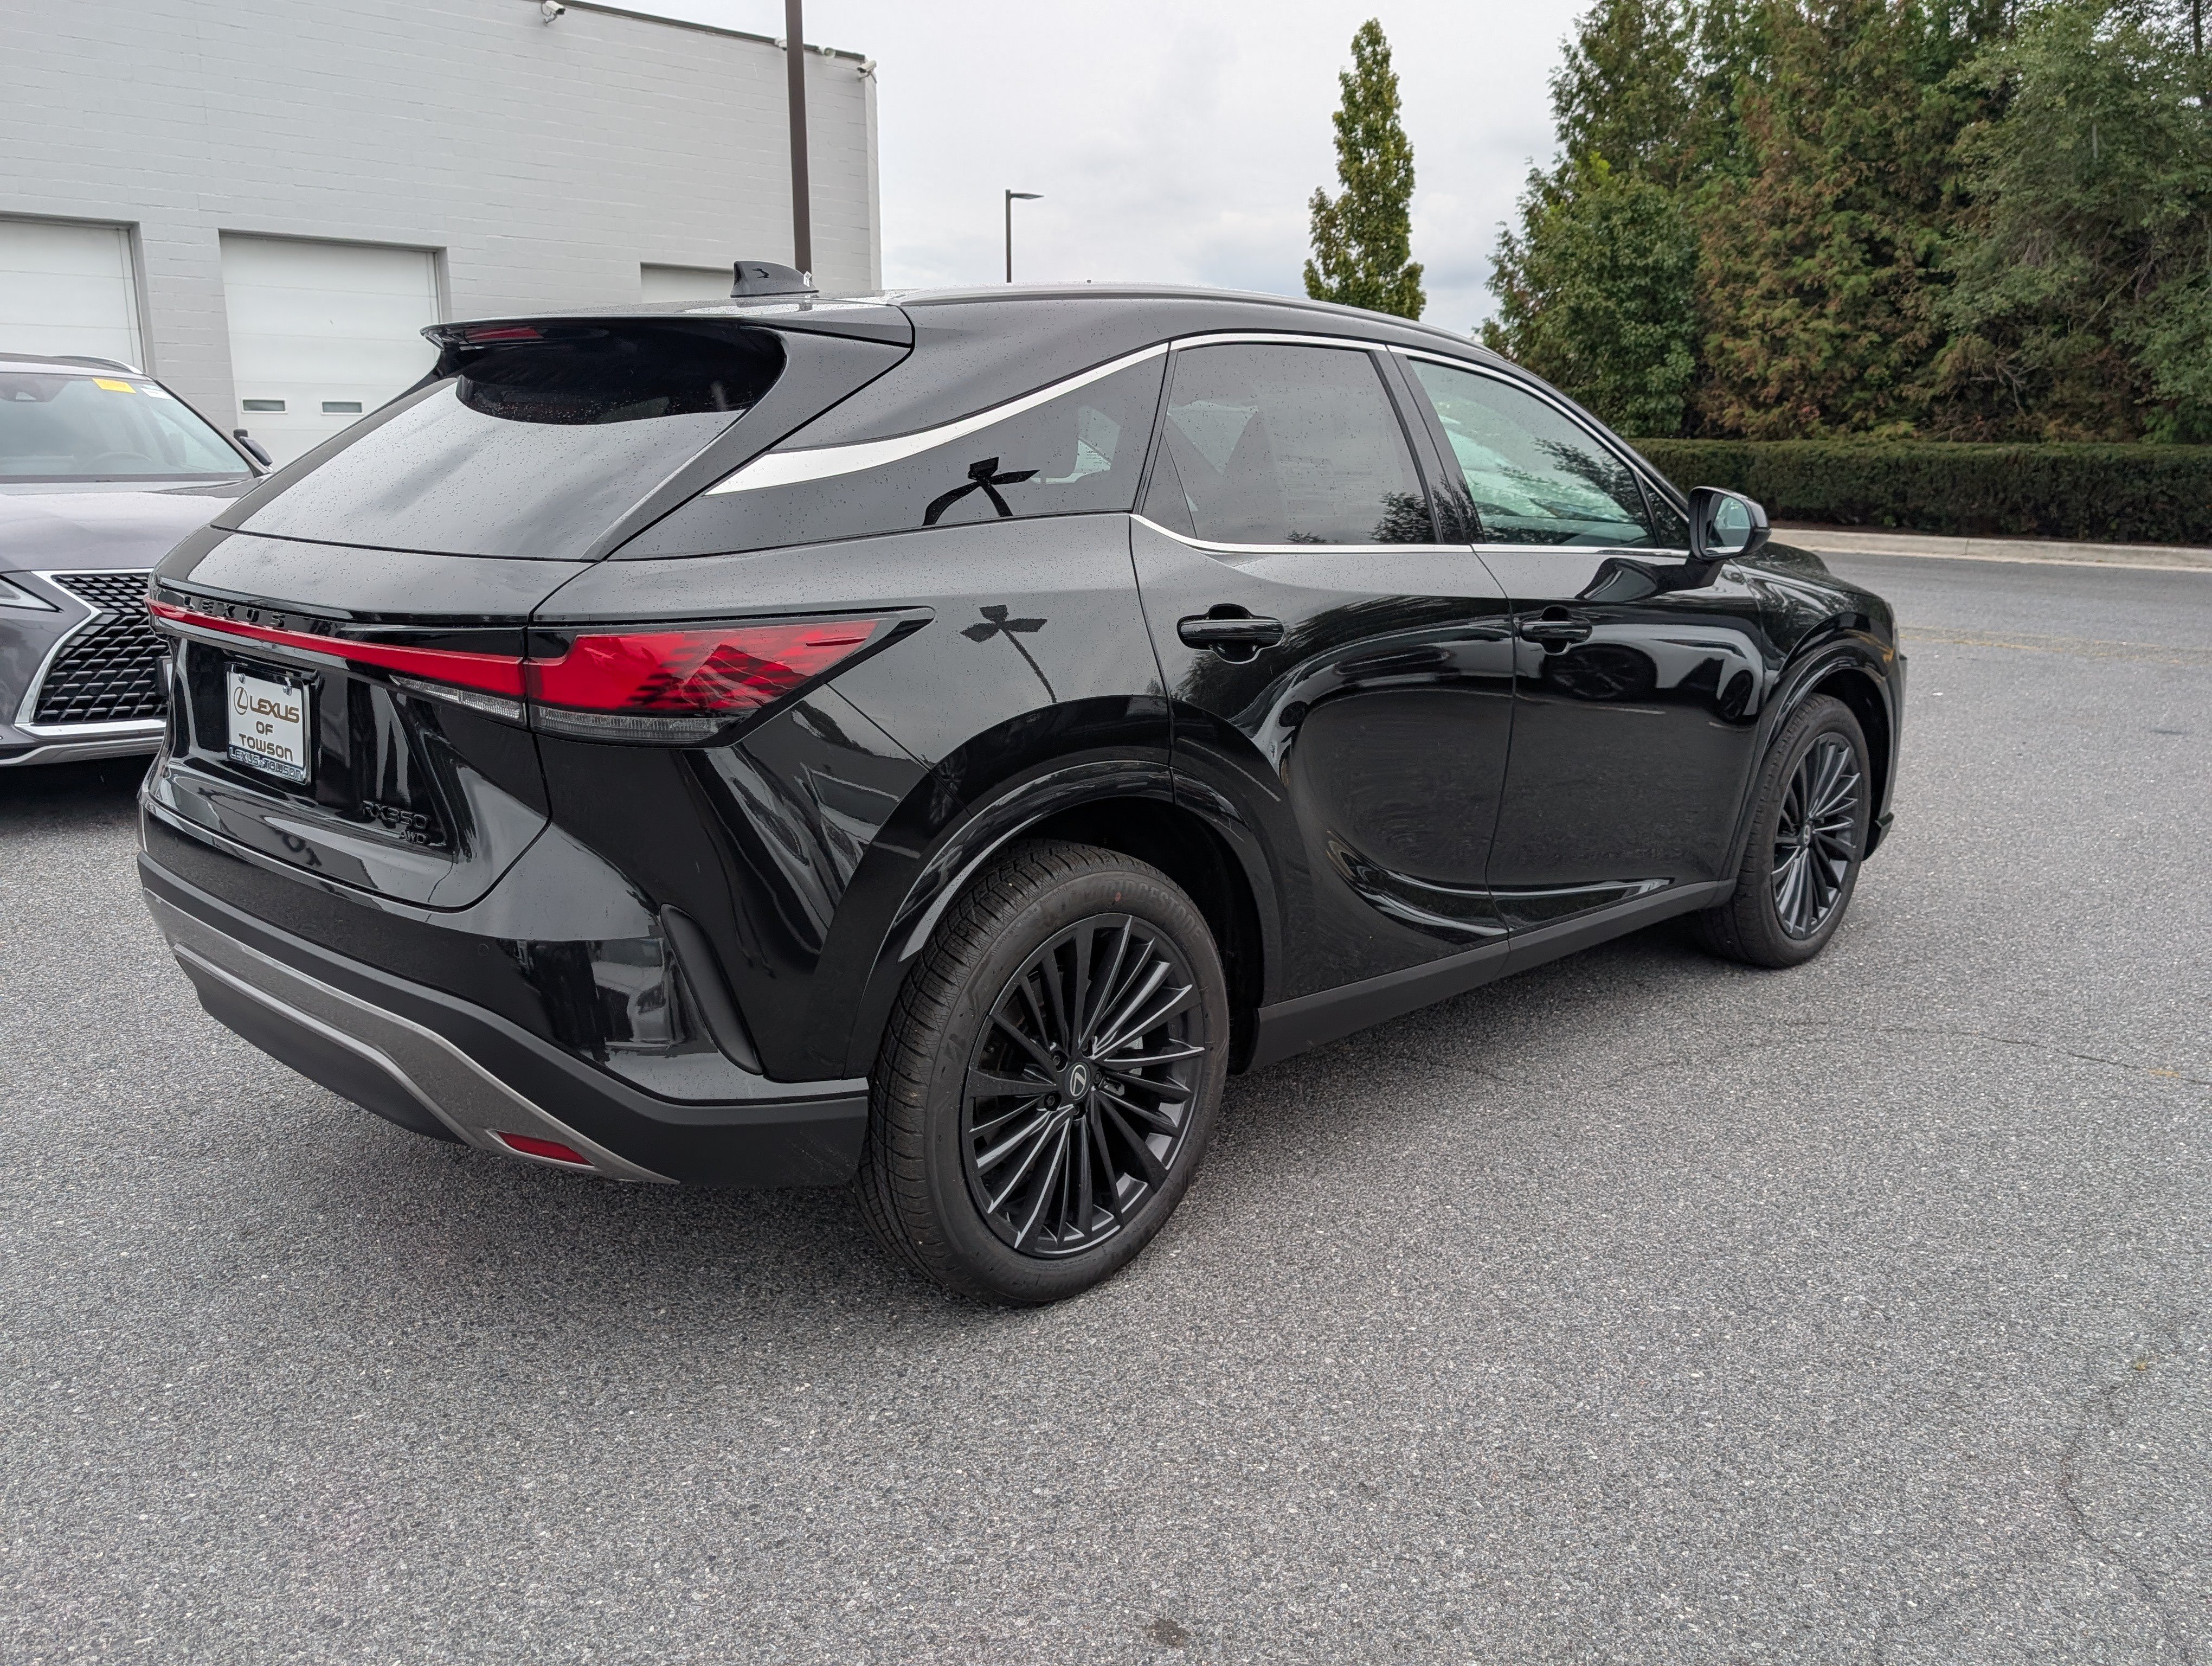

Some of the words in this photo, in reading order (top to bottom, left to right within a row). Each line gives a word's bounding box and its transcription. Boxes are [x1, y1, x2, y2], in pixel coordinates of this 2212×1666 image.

[183, 596, 286, 627] LEXUS
[249, 695, 300, 723] LEXUS
[256, 721, 273, 736] OF
[229, 747, 260, 767] LEXUS
[239, 733, 294, 762] TOWSON
[399, 829, 428, 844] AWD
[1086, 879, 1205, 943] RIDGESTONE
